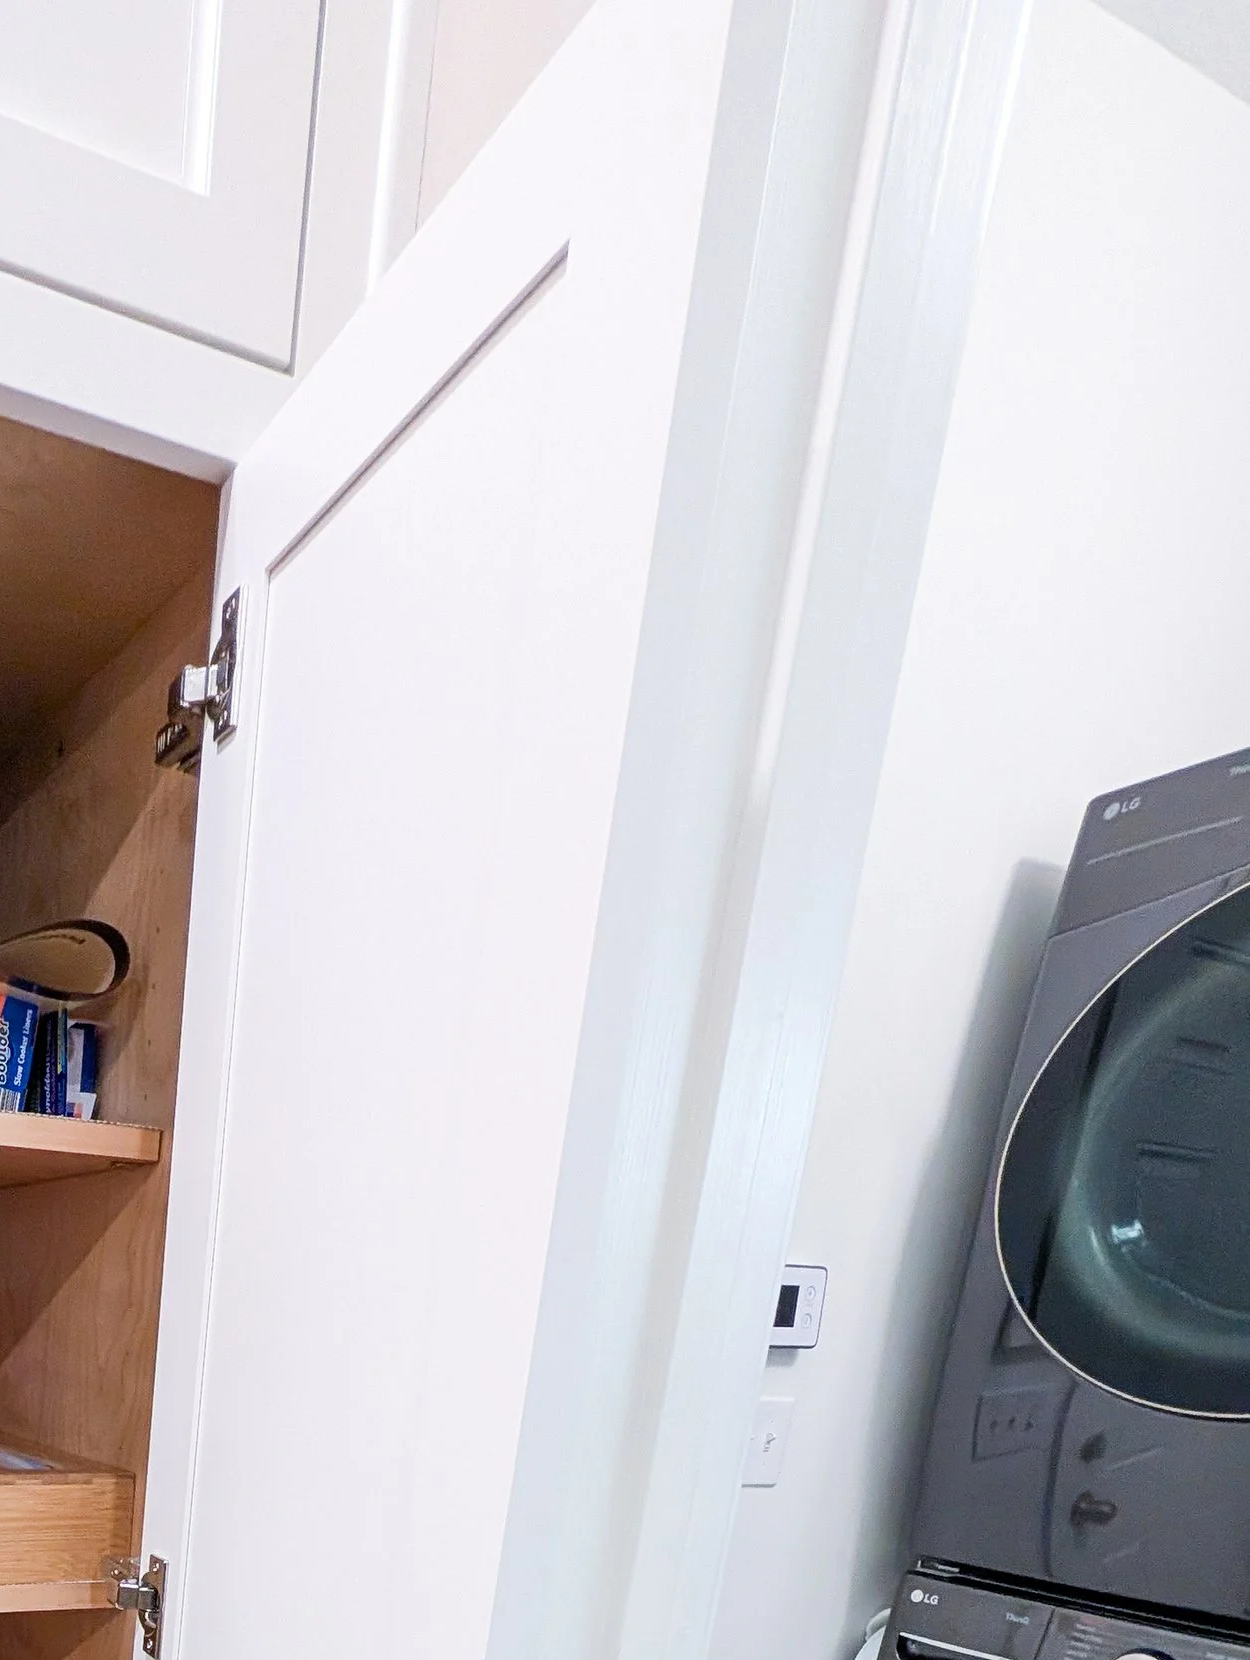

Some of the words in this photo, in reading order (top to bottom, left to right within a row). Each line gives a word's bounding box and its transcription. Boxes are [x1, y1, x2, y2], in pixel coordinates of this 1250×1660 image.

[1120, 796, 1142, 813] LG
[22, 1009, 33, 1035] Liners
[17, 1035, 28, 1064] Cooker
[14, 1066, 25, 1086] Slow
[923, 1593, 939, 1605] LG
